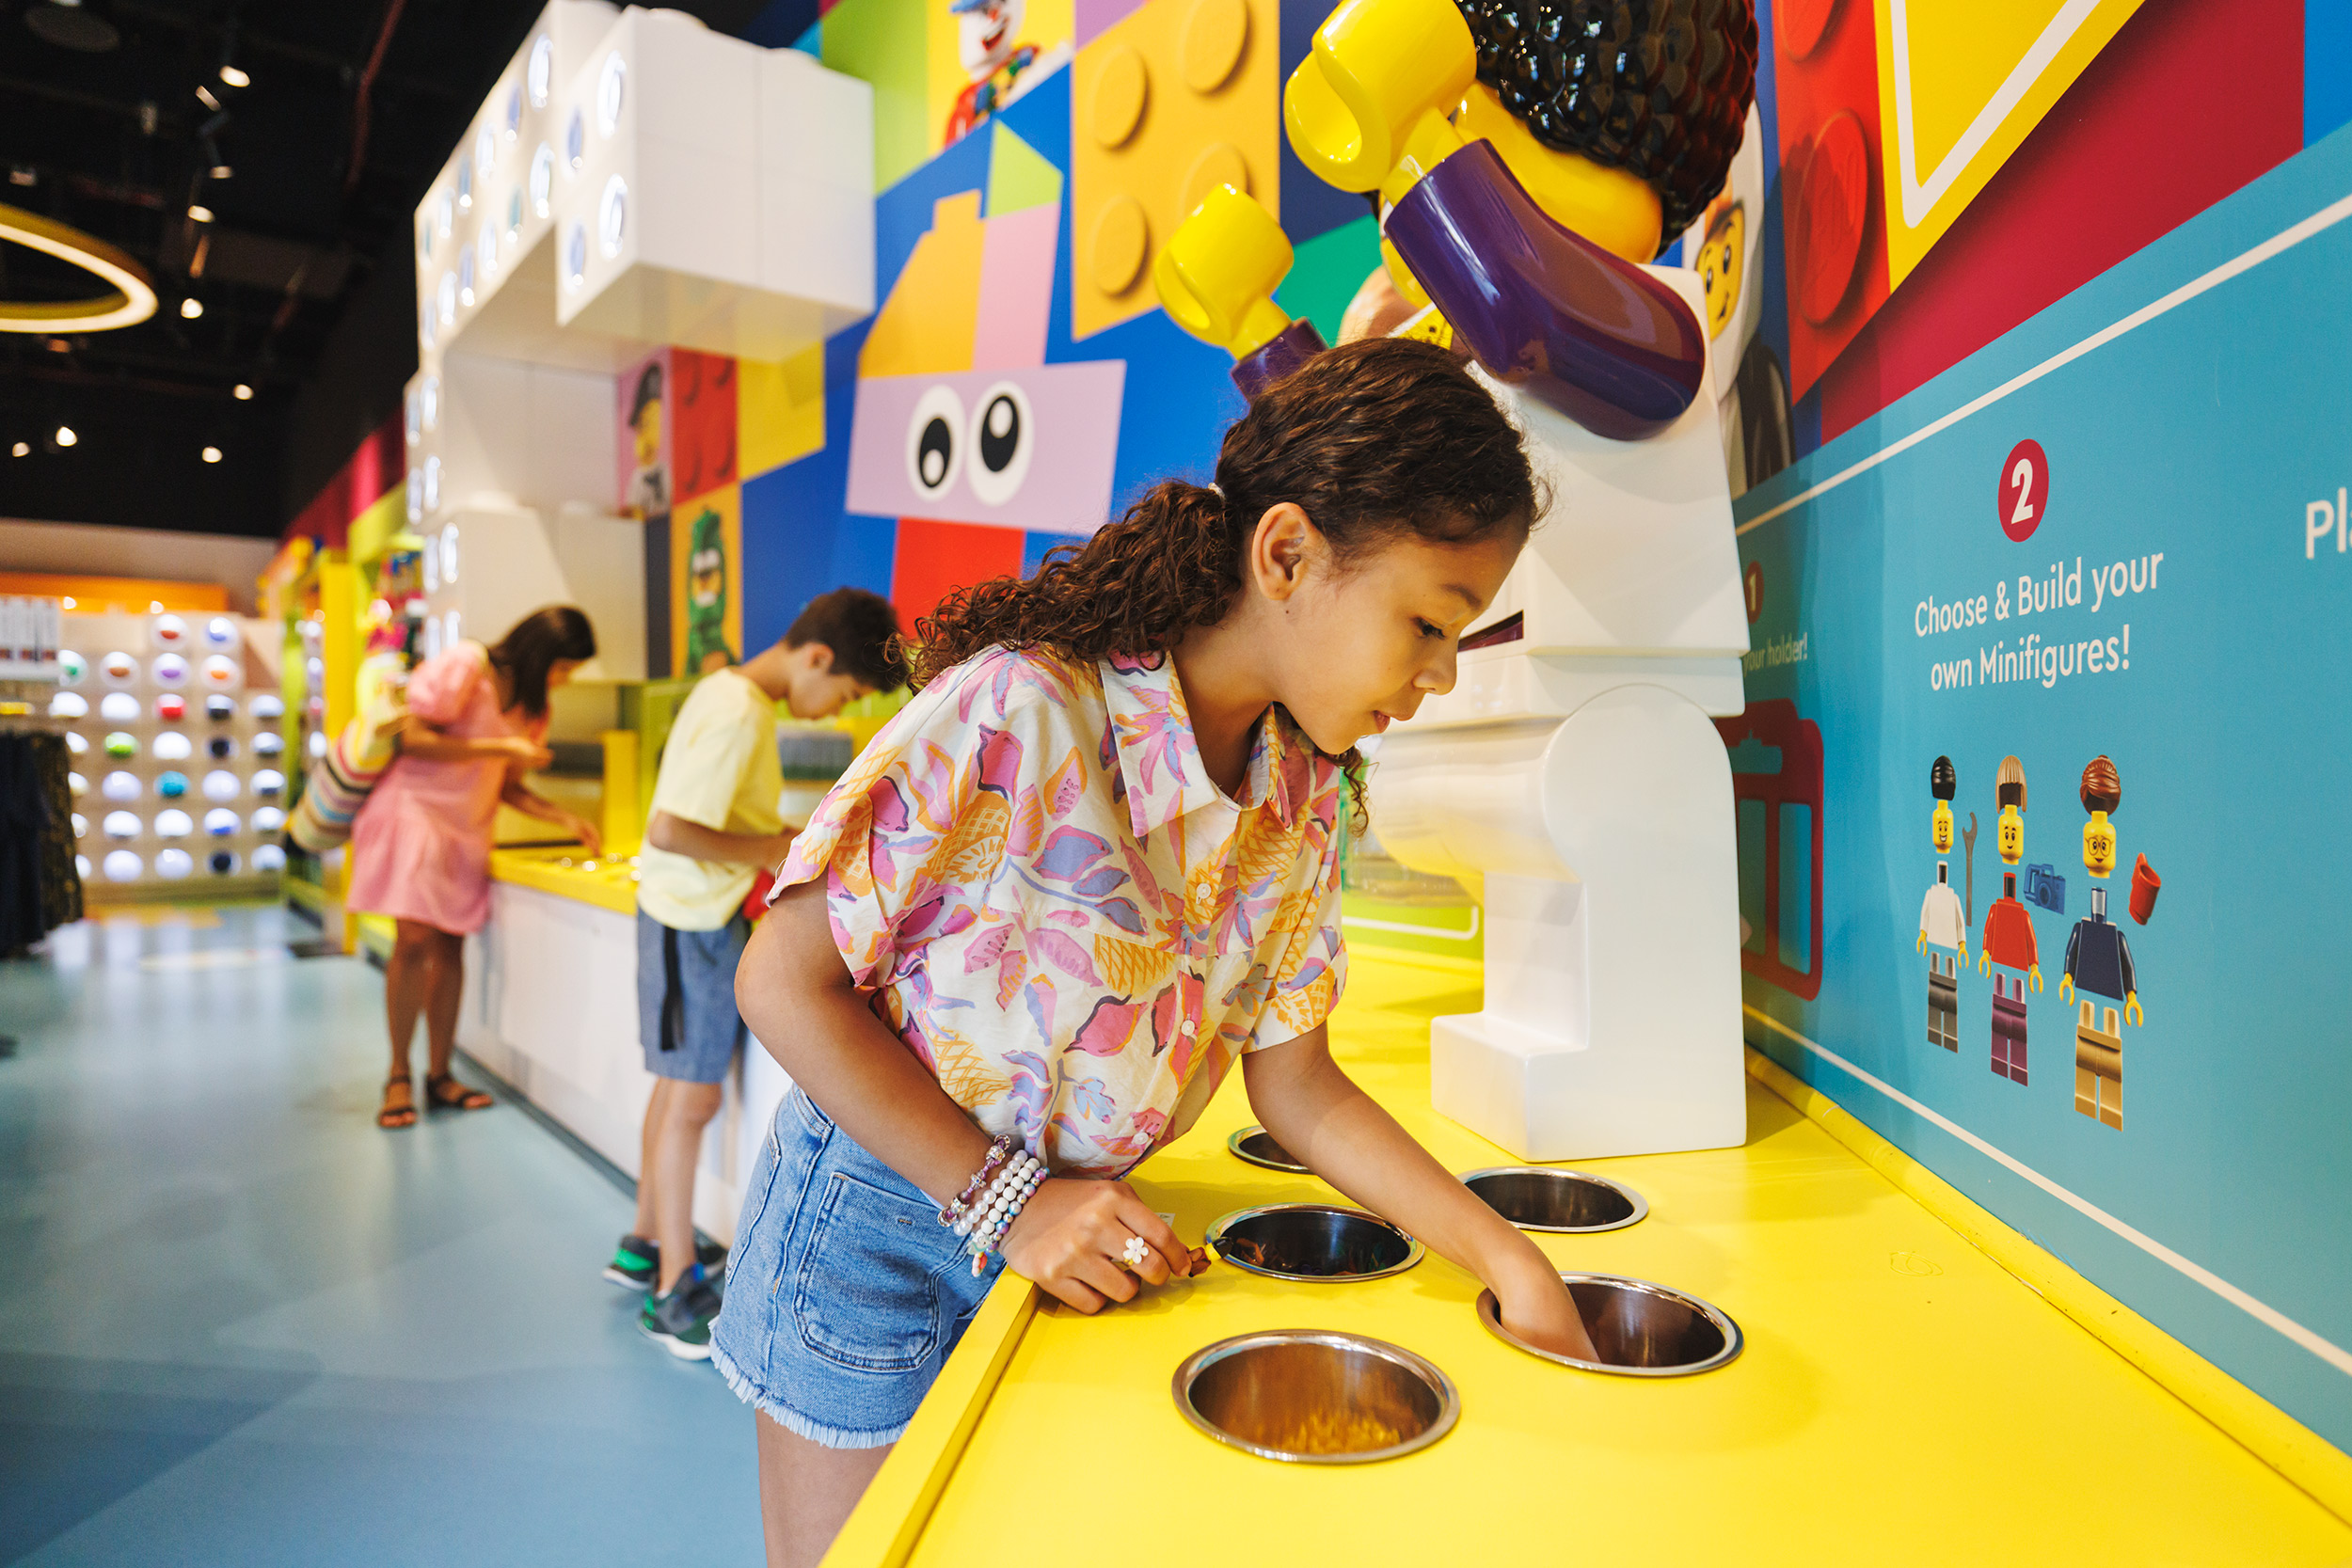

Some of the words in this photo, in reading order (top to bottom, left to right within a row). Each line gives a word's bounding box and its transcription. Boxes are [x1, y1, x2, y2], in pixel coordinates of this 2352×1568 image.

[2011, 458, 2033, 525] 2
[2306, 486, 2352, 560] Pl
[1749, 572, 1756, 611] 1
[1915, 594, 1988, 638] Choose
[1994, 580, 2010, 621] &
[2018, 556, 2082, 616] Build
[2091, 551, 2164, 613] your
[1767, 631, 1808, 666] holder!
[1931, 657, 1973, 691] own
[1979, 623, 2130, 689] Minifigures!
